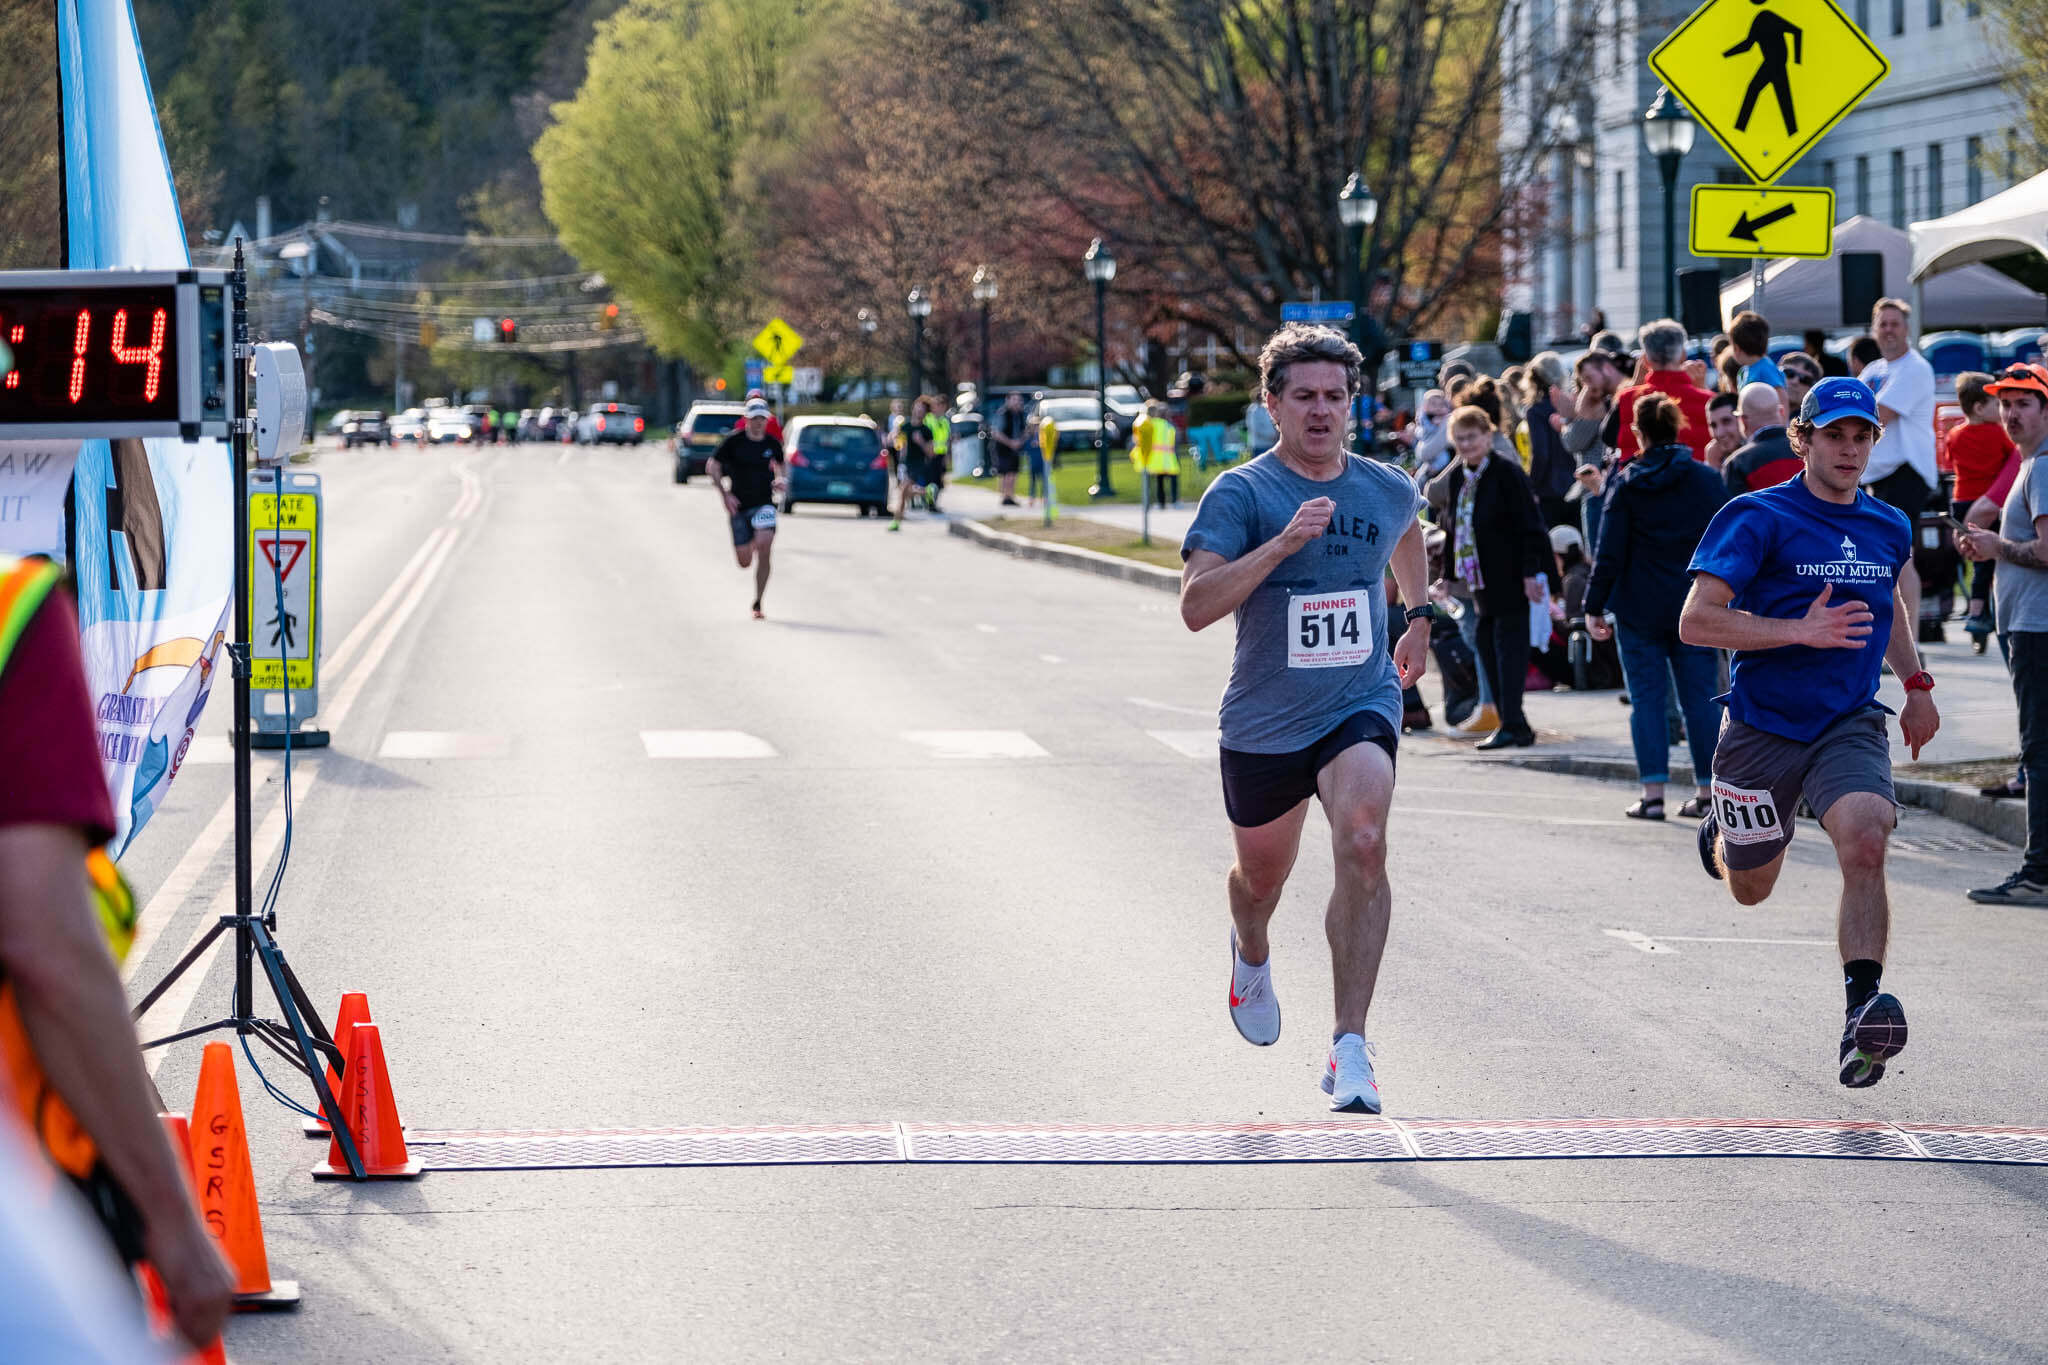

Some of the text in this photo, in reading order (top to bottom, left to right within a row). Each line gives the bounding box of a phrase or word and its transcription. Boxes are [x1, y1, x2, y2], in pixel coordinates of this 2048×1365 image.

[263, 498, 304, 512] STATE
[268, 514, 297, 525] LAW
[1326, 514, 1380, 545] ALER
[1796, 564, 1846, 576] UNION
[1303, 597, 1356, 611] RUNNER
[1301, 611, 1360, 648] 514
[254, 675, 306, 688] CROSSALK
[1714, 785, 1759, 803] RUNNER
[1713, 794, 1776, 830] 1610
[205, 1114, 228, 1239] GSRS
